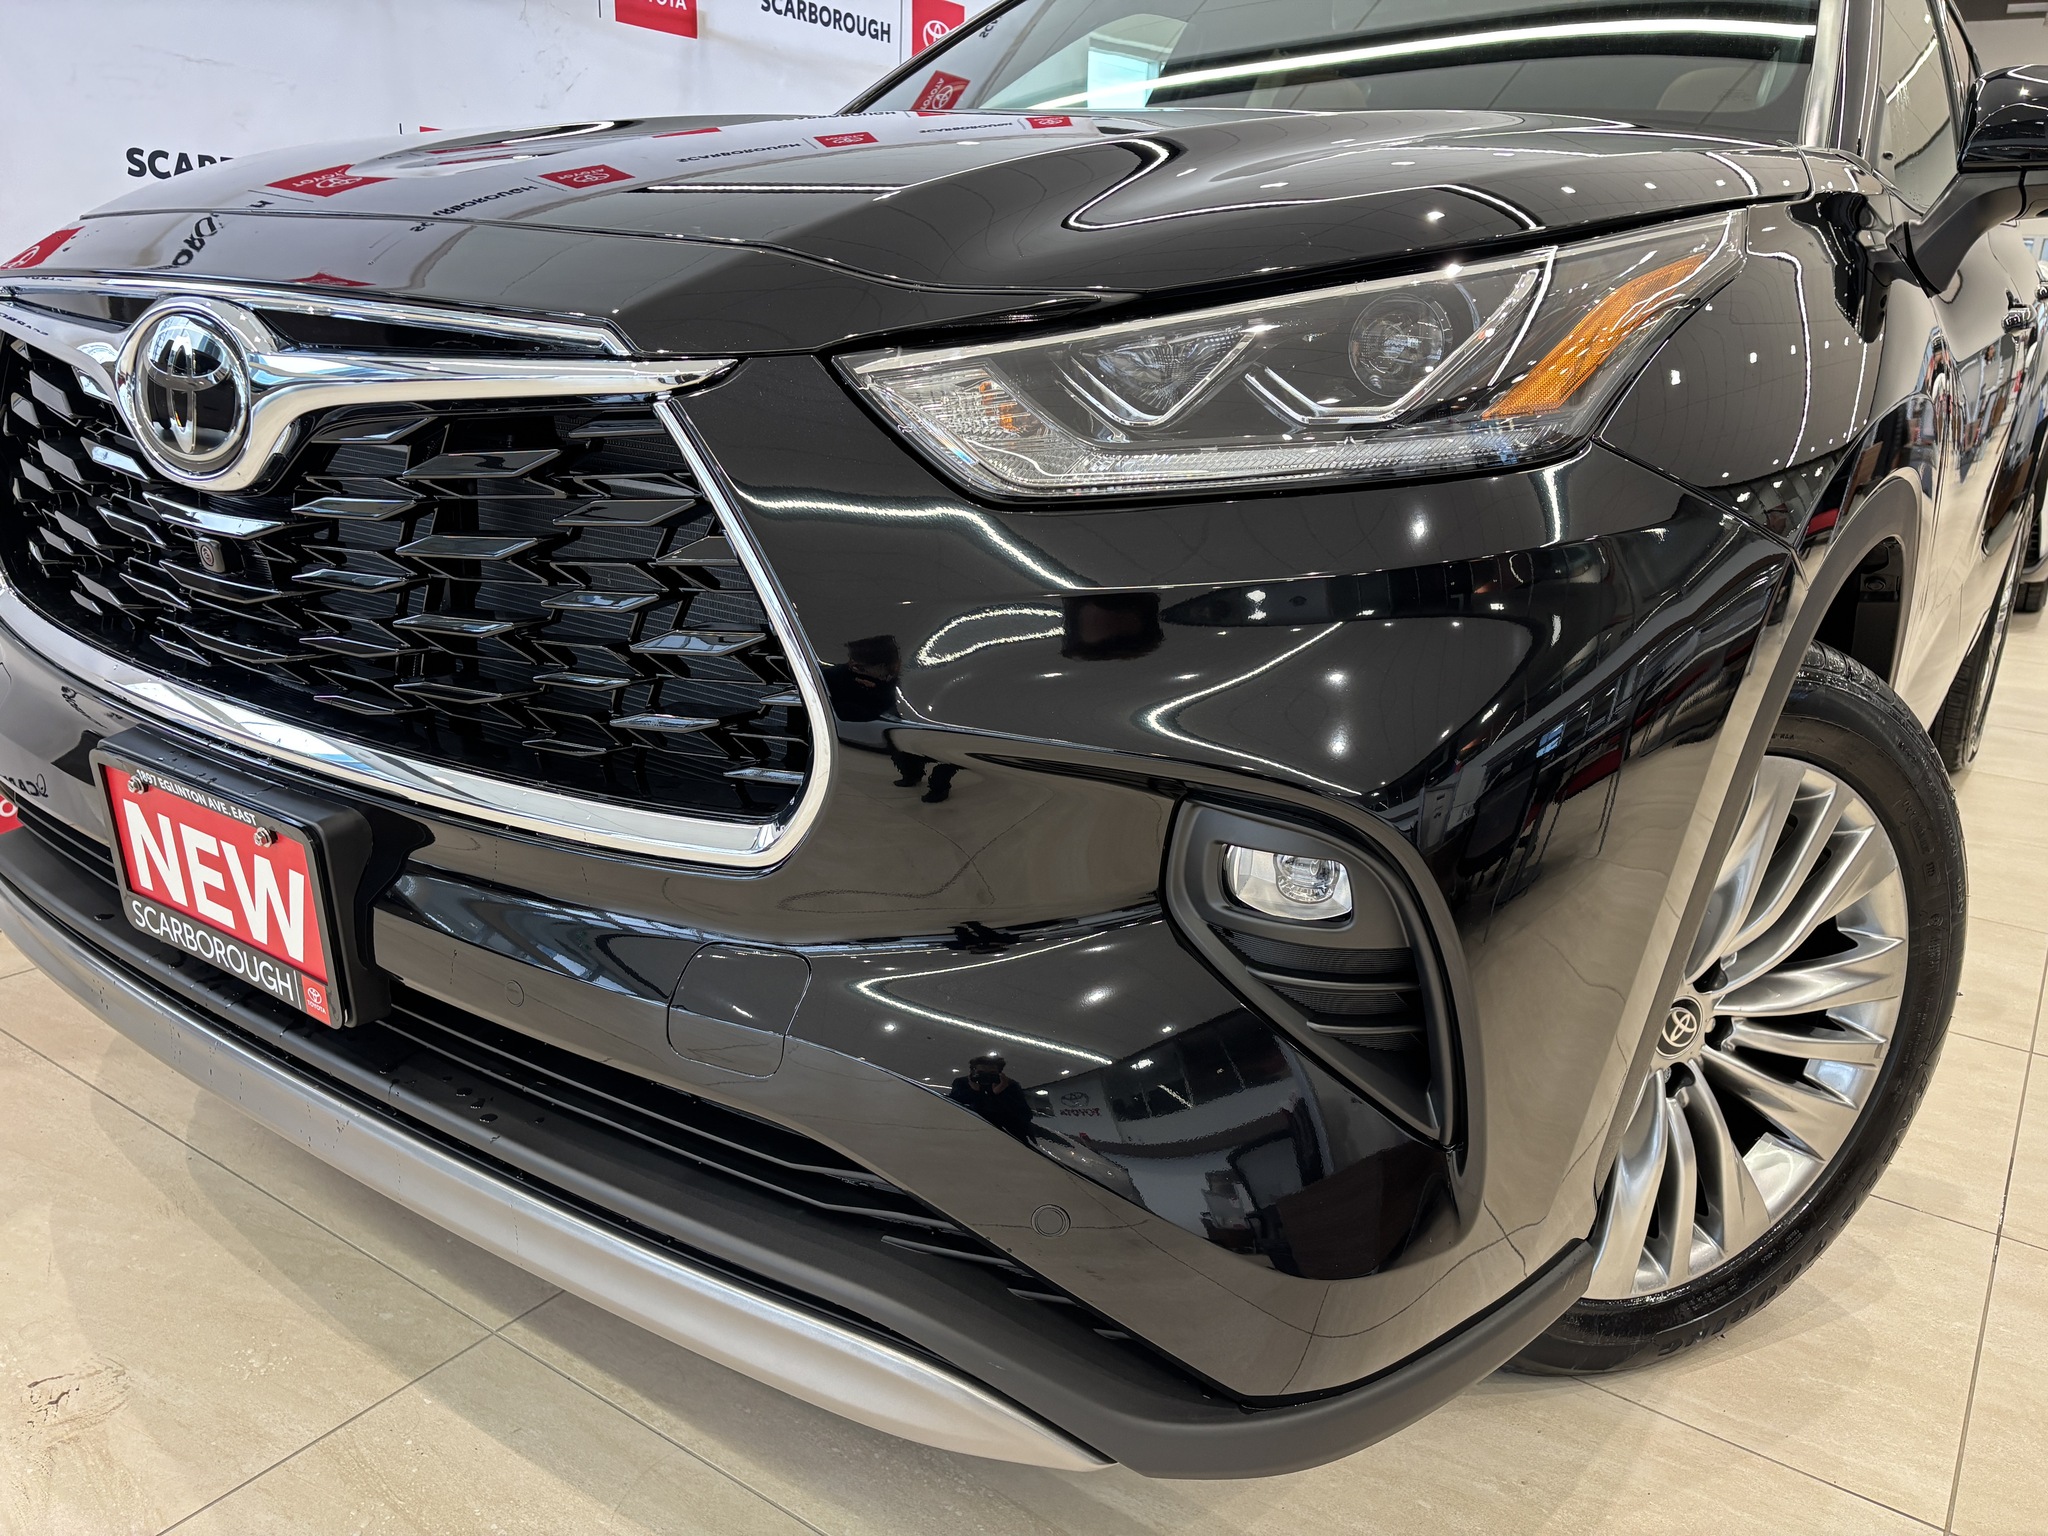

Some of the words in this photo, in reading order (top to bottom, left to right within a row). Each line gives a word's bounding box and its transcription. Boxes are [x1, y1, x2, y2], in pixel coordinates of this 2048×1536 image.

[136, 769, 158, 786] 1897
[158, 777, 208, 807] EGLINTON
[208, 798, 232, 817] AVE.
[230, 805, 257, 826] EAST
[122, 798, 304, 963] NEW
[132, 899, 295, 1002] SCARBOROUGH
[306, 999, 327, 1015] TOYOTA
